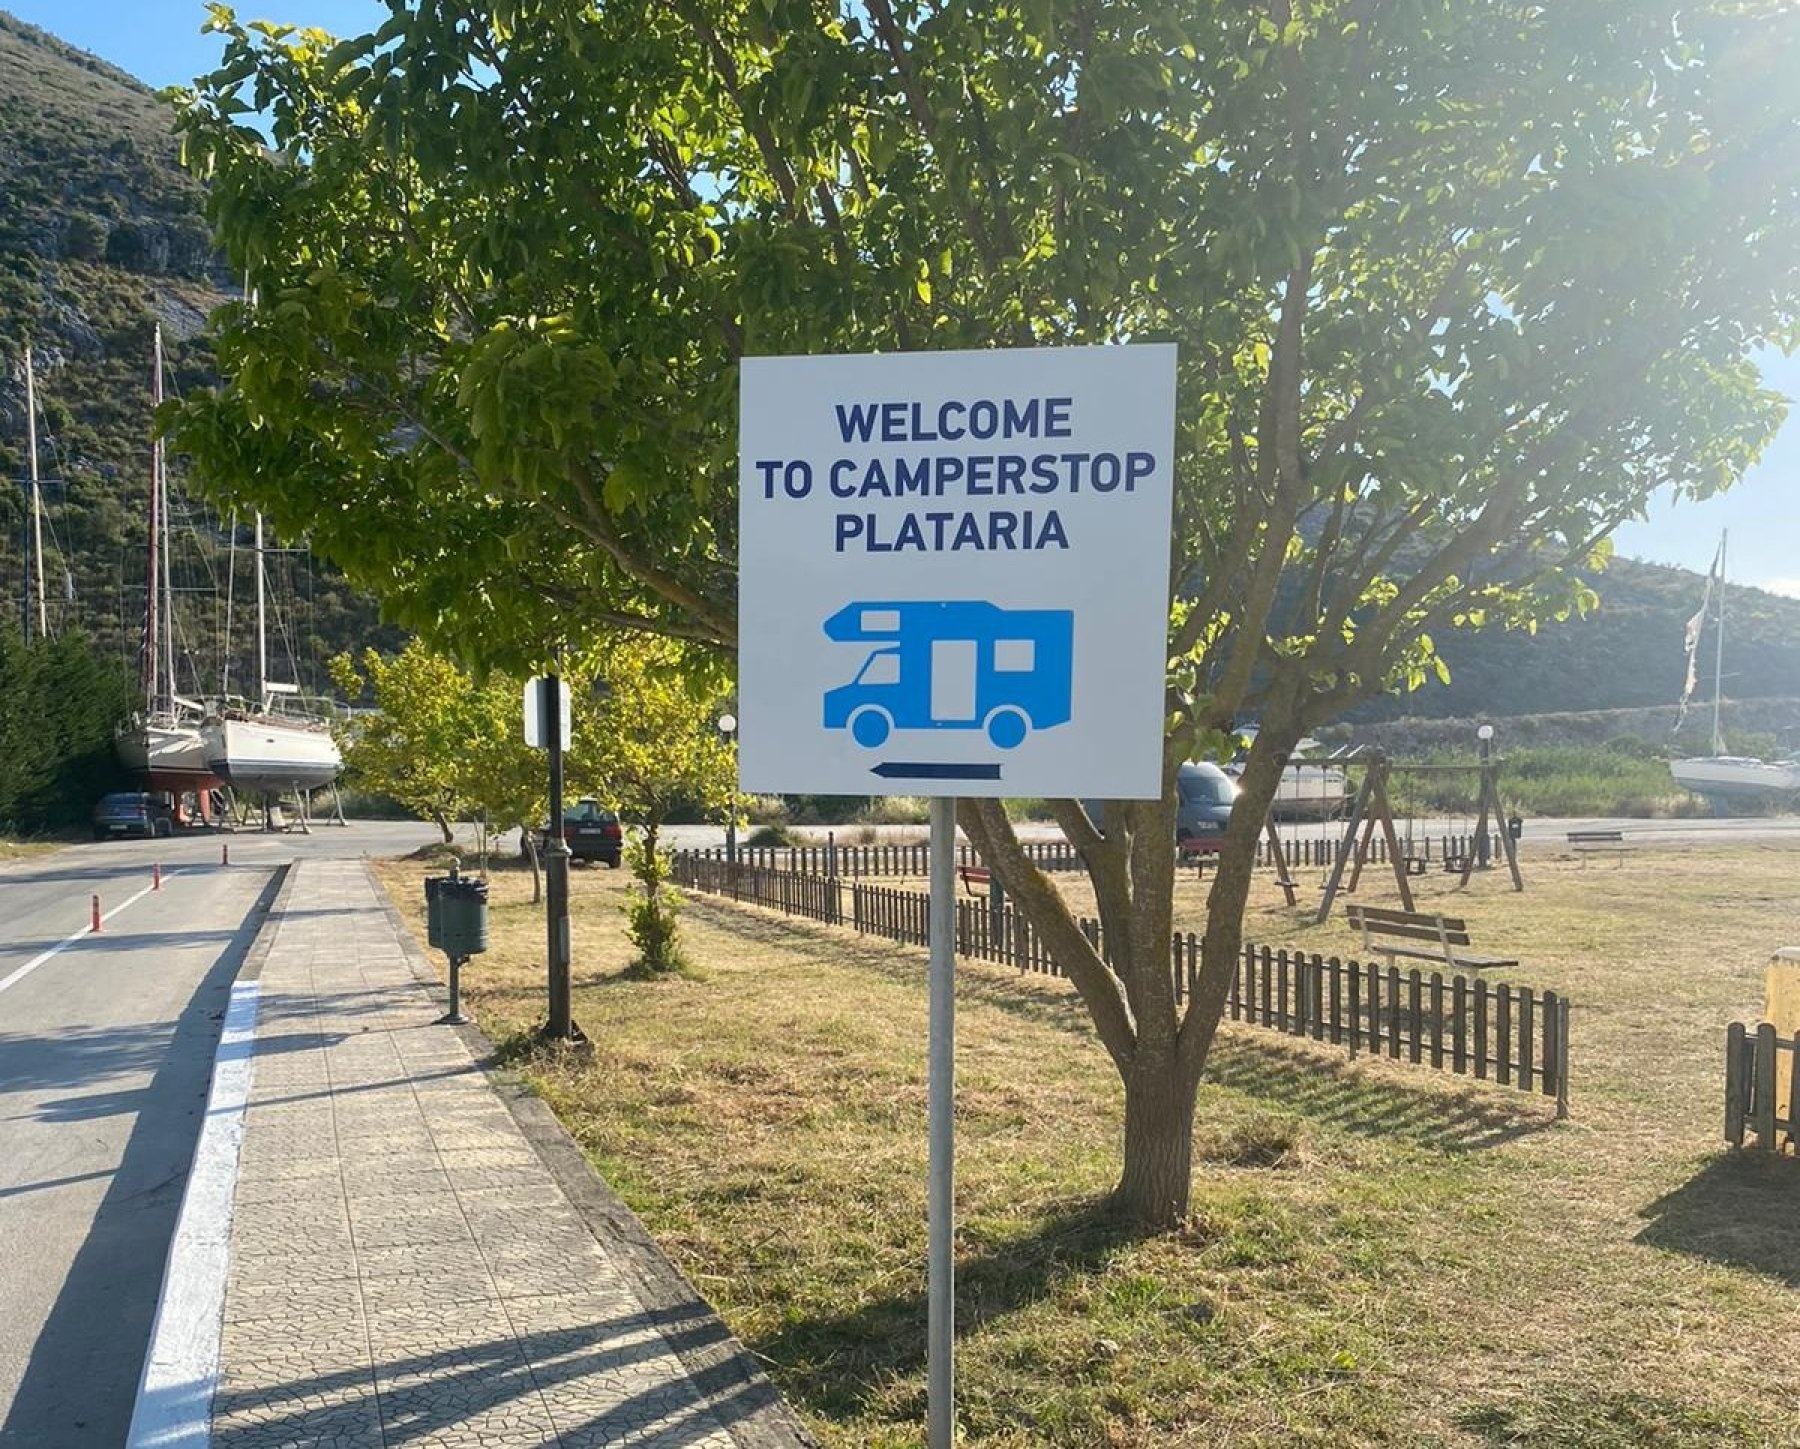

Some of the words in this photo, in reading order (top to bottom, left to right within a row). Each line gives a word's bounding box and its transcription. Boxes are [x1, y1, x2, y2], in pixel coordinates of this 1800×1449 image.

[835, 397, 1073, 443] WELCOME
[755, 459, 813, 499] TO
[829, 452, 1156, 499] CAMPERSTOP
[835, 510, 1070, 553] PLATARIA
